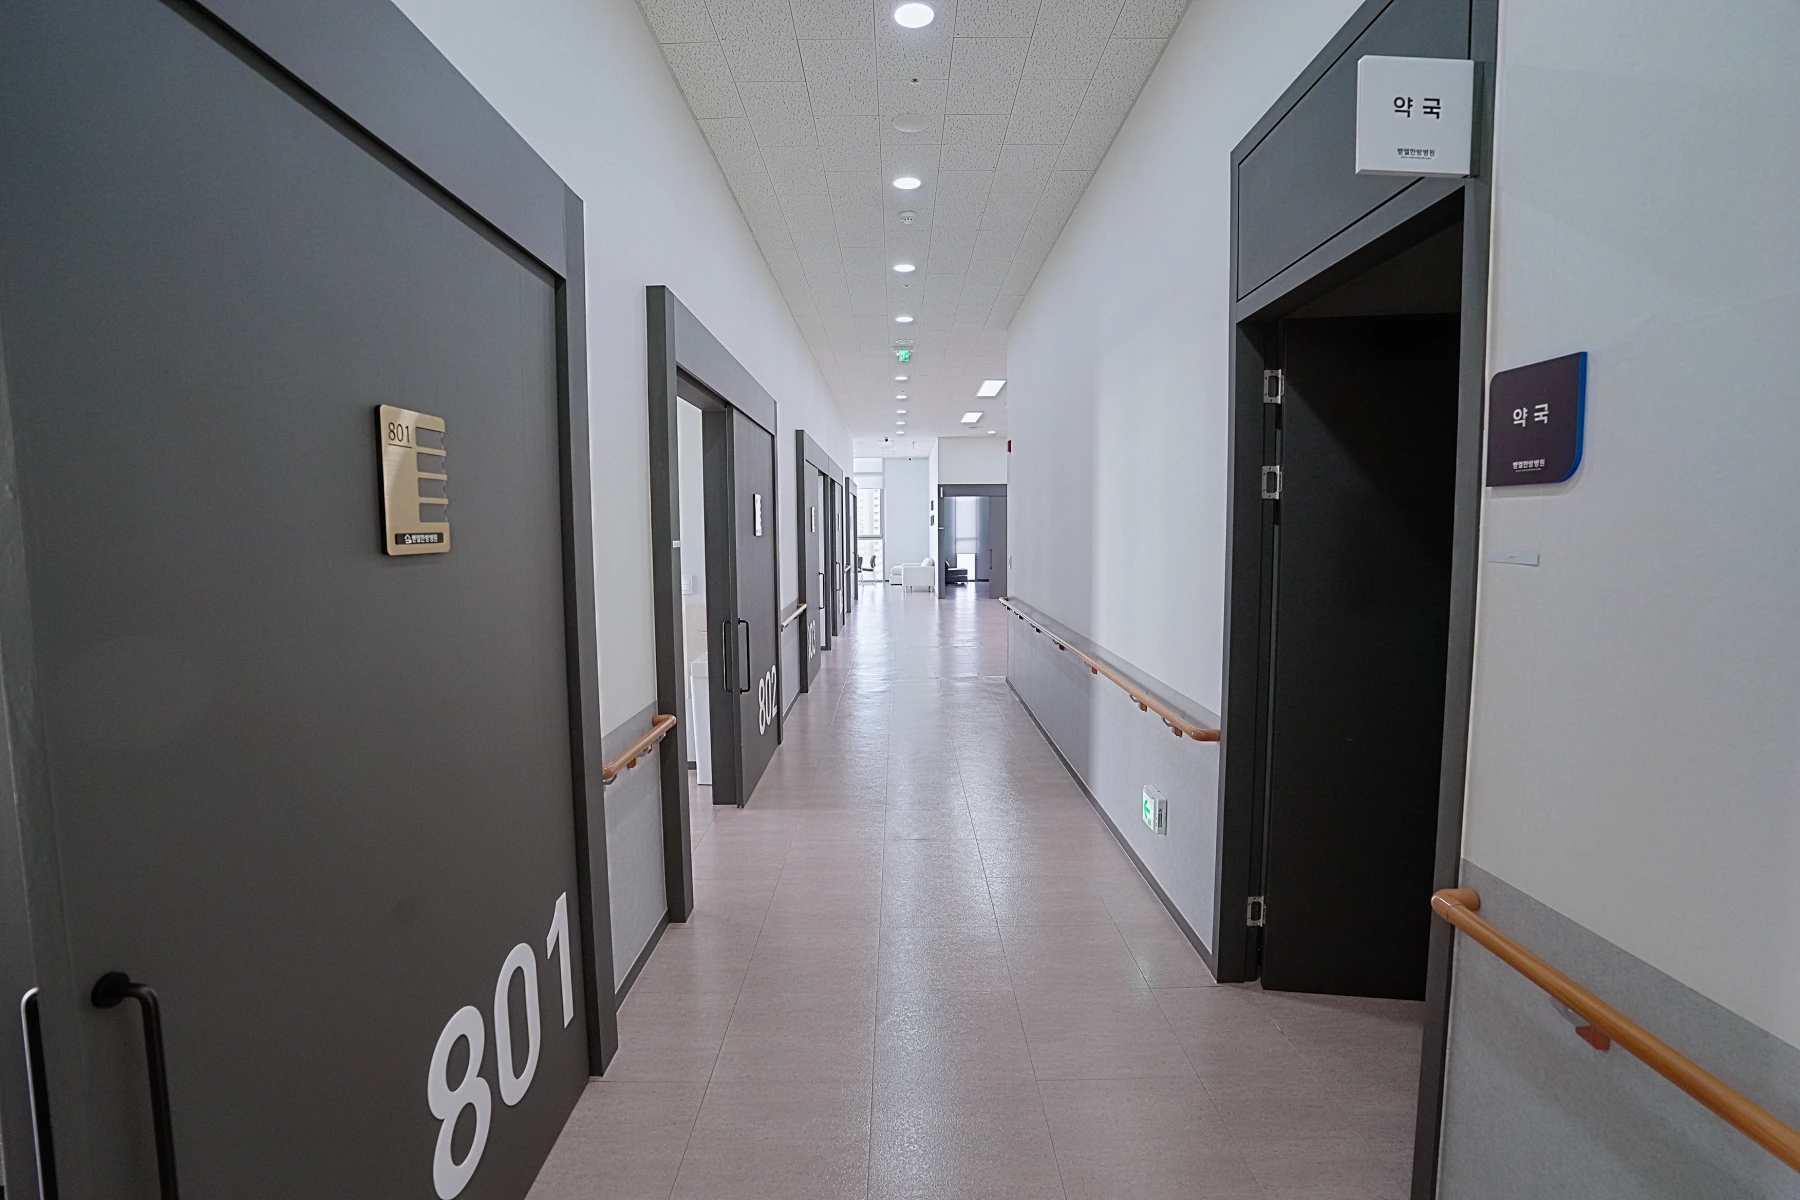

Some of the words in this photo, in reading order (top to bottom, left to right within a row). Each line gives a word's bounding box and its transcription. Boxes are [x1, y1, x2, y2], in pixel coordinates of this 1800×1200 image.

[388, 422, 410, 444] 801
[758, 664, 778, 736] 802
[427, 891, 574, 1200] 801
